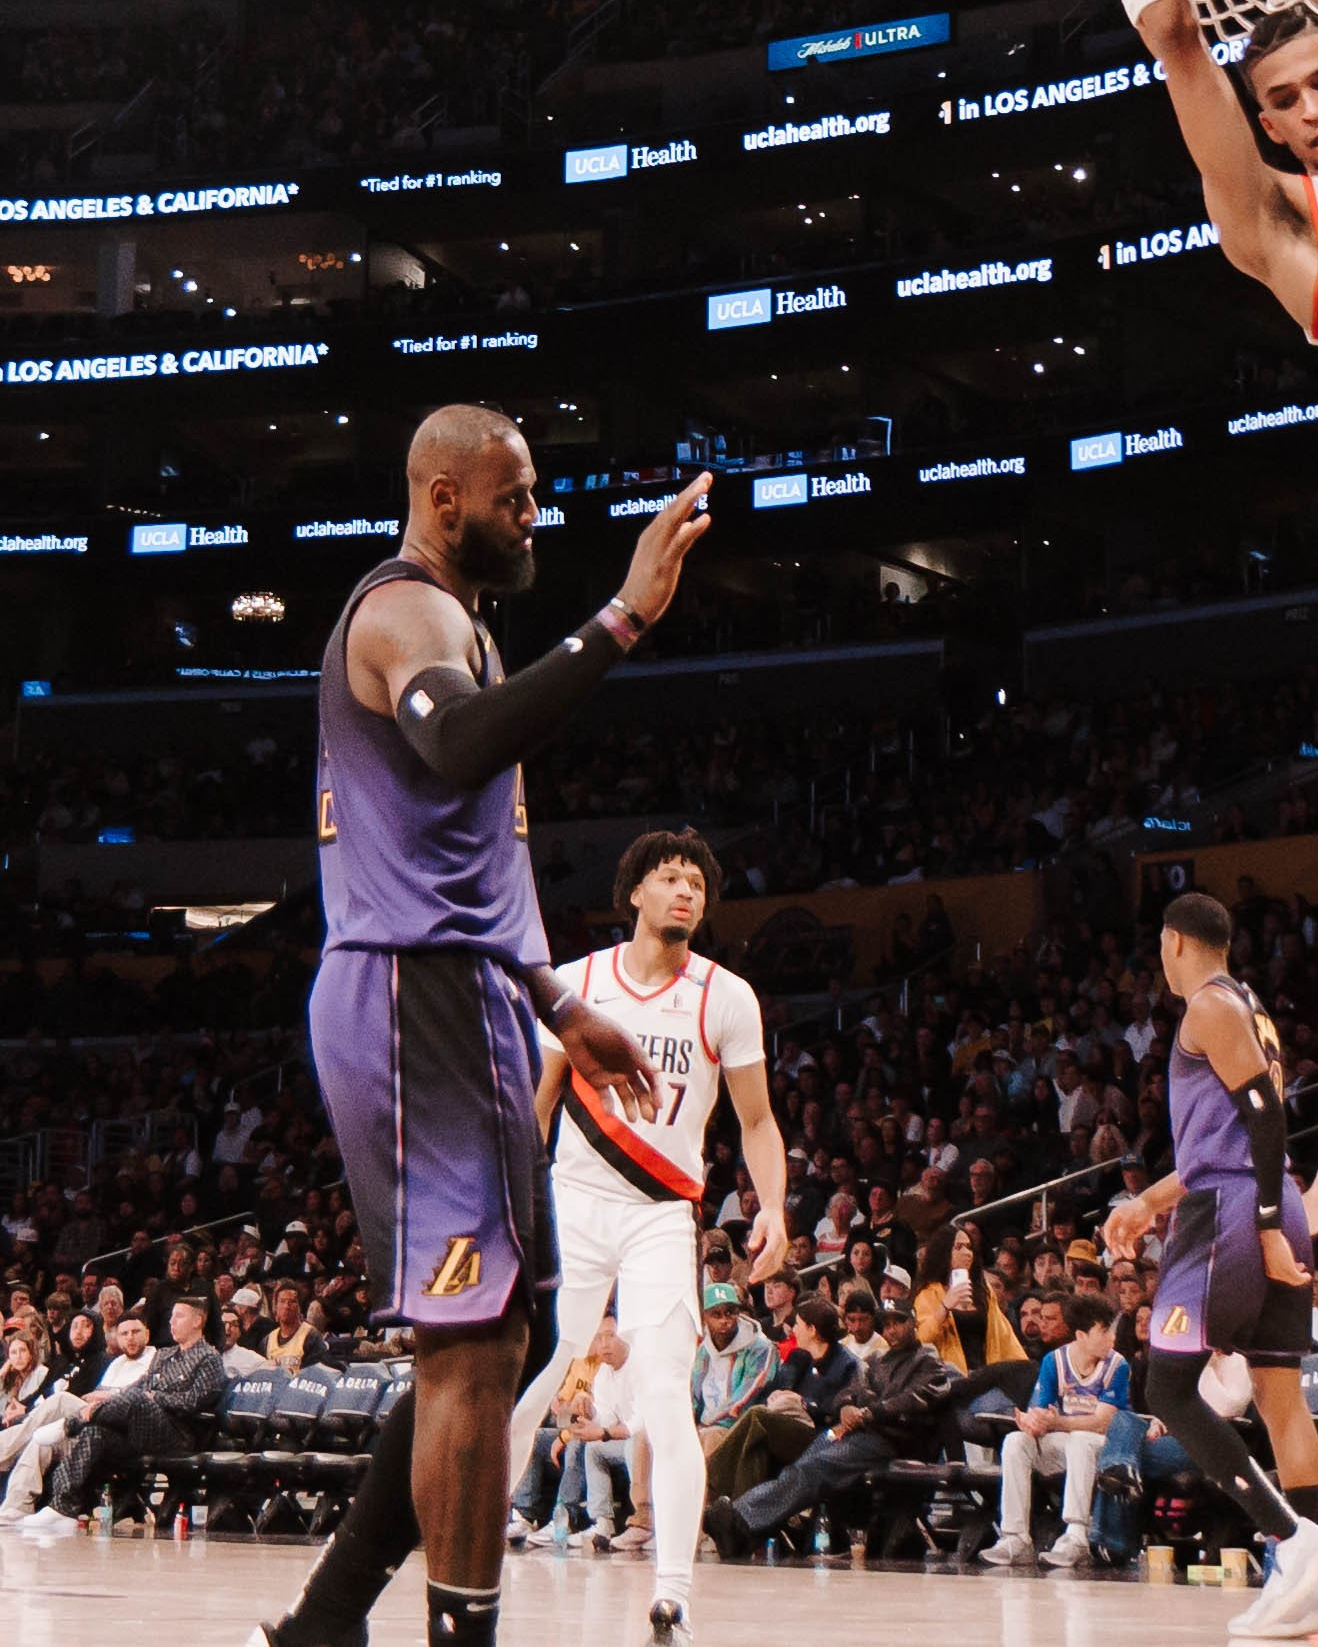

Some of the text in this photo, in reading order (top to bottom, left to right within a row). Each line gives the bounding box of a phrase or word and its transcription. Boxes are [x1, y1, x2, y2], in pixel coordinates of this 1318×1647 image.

[864, 24, 923, 47] ULTRA
[958, 98, 981, 121] in
[984, 88, 1029, 117] LOS
[1031, 67, 1131, 110] ANGELES
[1132, 62, 1151, 87] &
[743, 111, 891, 151] uclahealth.org
[574, 140, 698, 175] UCLA Health
[402, 174, 424, 190] for
[425, 173, 443, 189] #1
[446, 169, 502, 188] ranking
[30, 195, 133, 221] ANGELES
[136, 194, 154, 216] &
[1115, 241, 1137, 266] in
[1140, 228, 1185, 259] LOS
[896, 258, 1053, 297] uclahealth.org
[716, 285, 847, 322] UCLA Health
[436, 336, 457, 352] for
[460, 334, 478, 350] #1
[482, 331, 539, 350] ranking
[7, 358, 54, 383] LOS
[55, 354, 158, 381] ANGELES
[160, 352, 179, 374] &
[1077, 427, 1184, 463] UCLA Health
[919, 456, 1026, 484] uclahealth.org
[760, 472, 872, 501] UCLA Health
[139, 524, 250, 547] UCLA Health
[295, 518, 400, 540] uclahealth.org
[242, 1381, 273, 1394] DELTA
[298, 1378, 329, 1398] DELTA
[345, 1376, 379, 1391] DELTA
